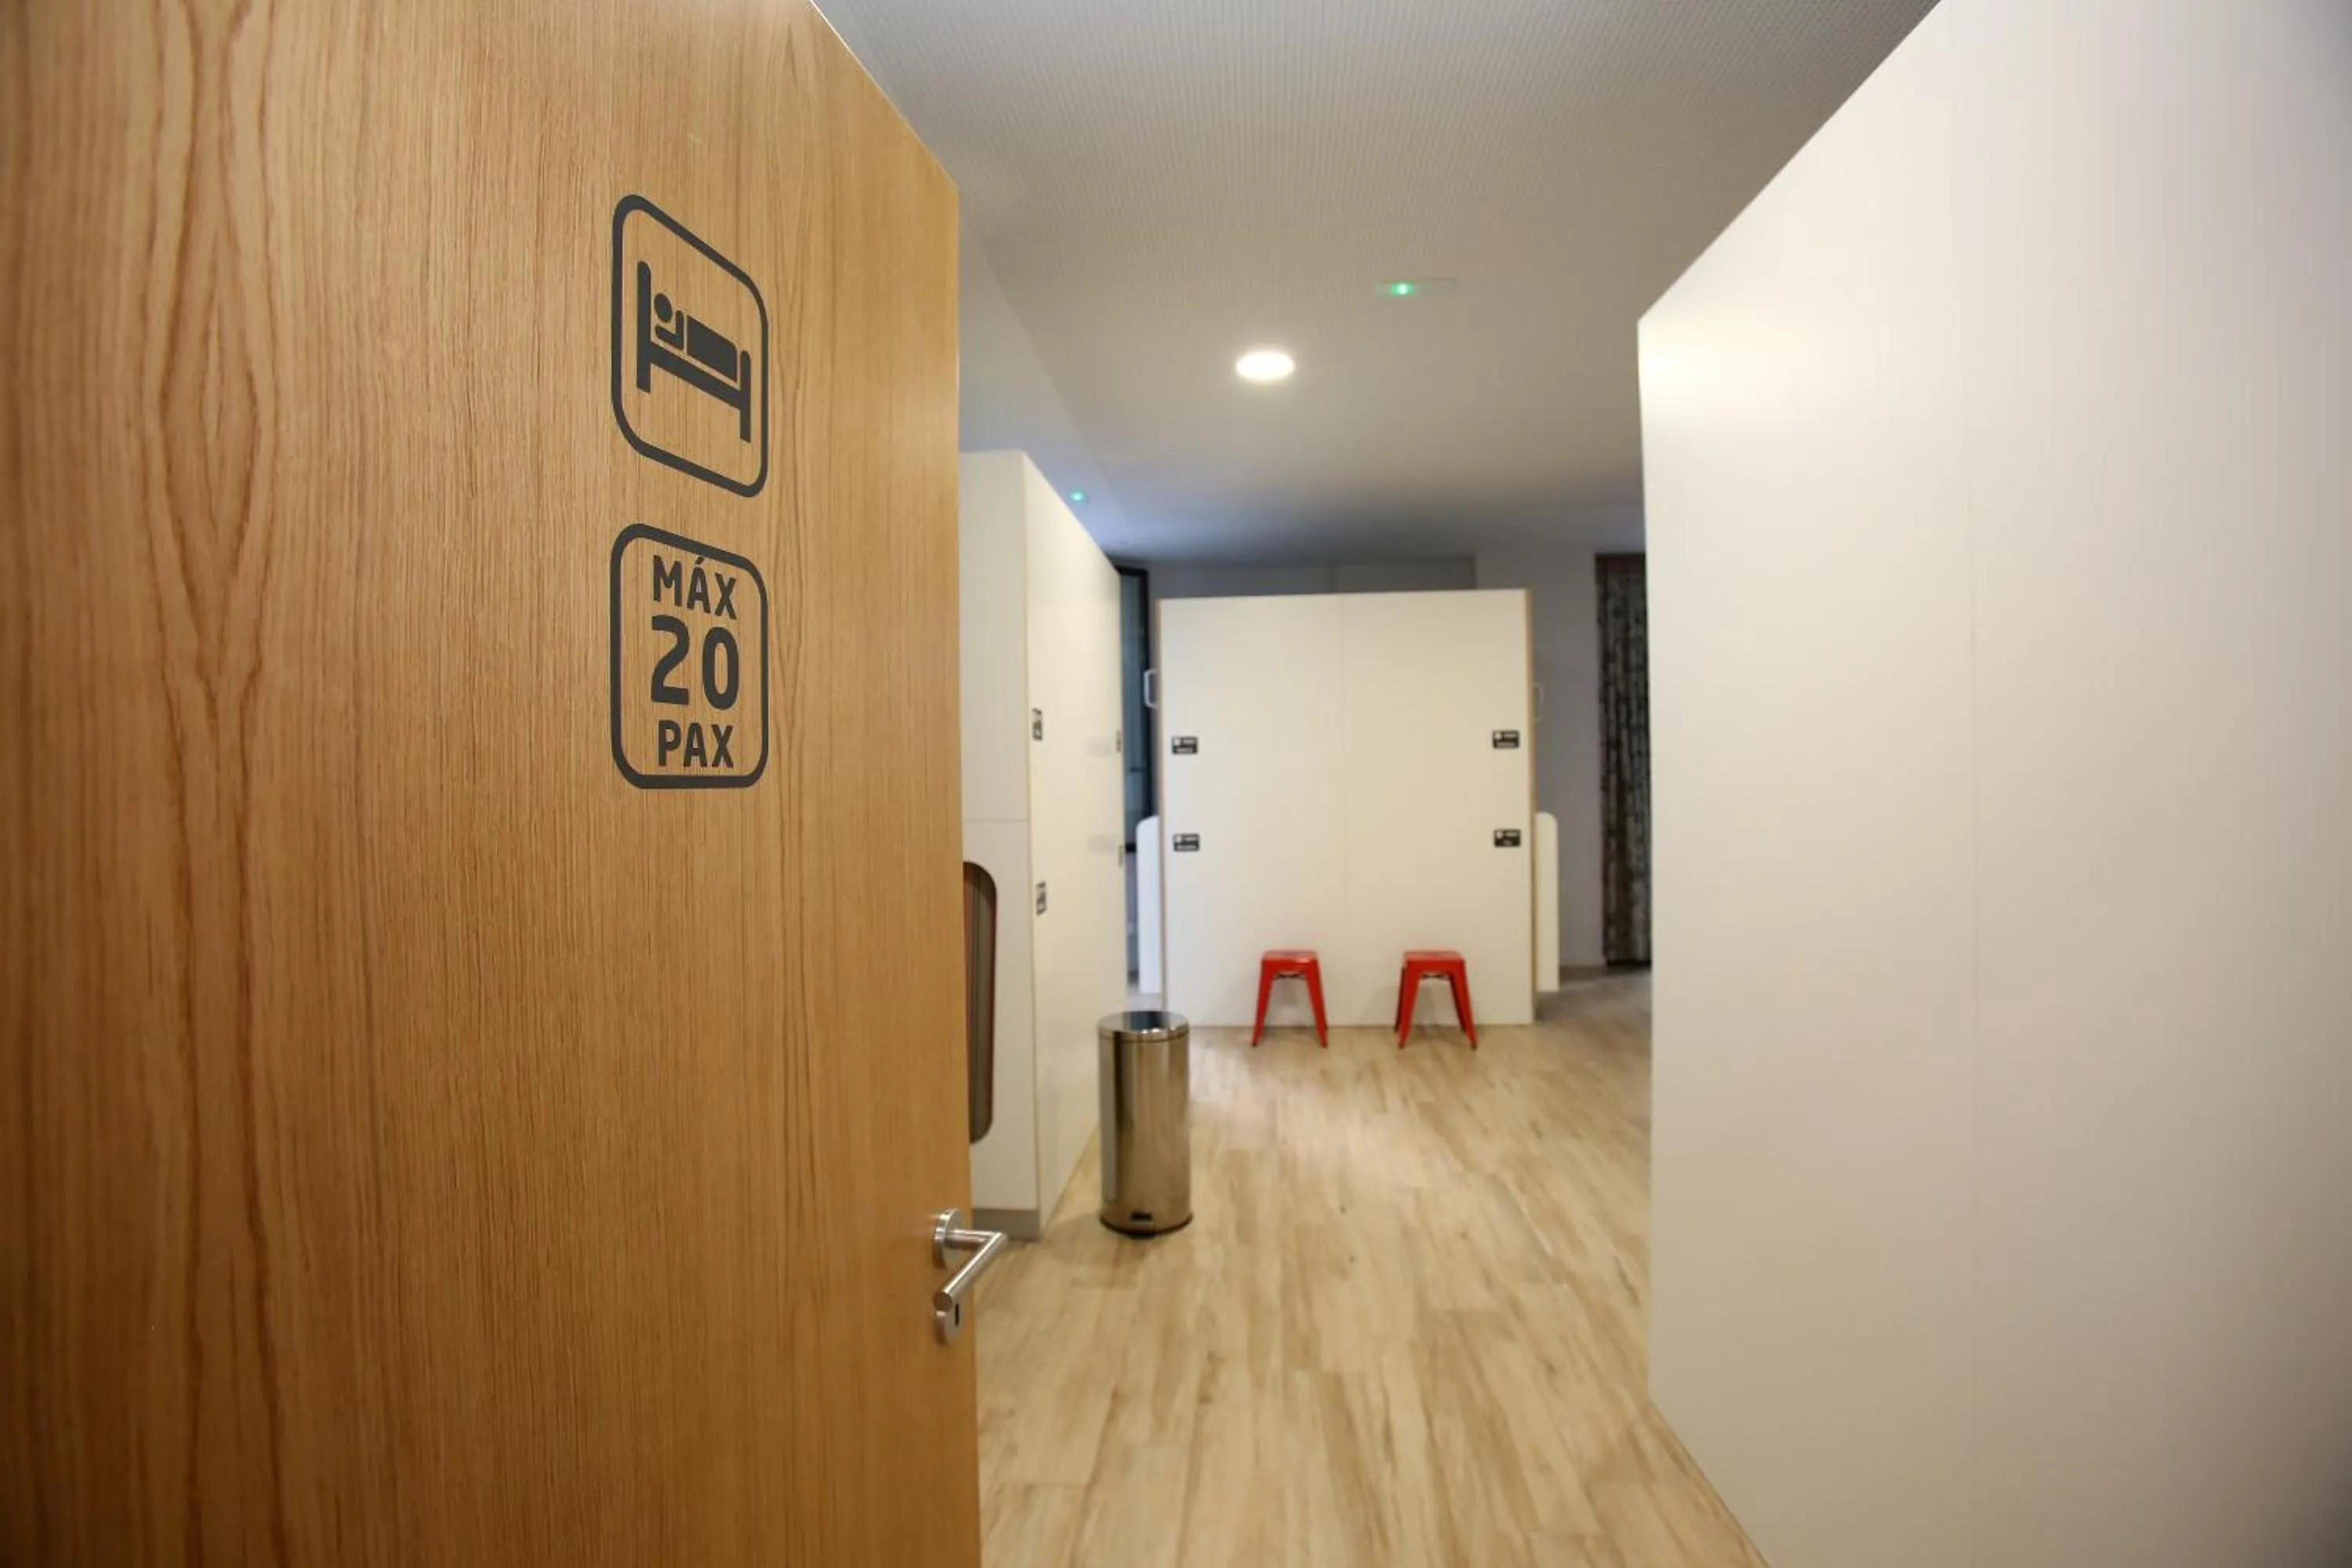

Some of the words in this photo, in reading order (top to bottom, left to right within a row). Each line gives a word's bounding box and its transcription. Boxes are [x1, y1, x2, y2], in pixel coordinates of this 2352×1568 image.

[652, 554, 737, 620] MÁX
[651, 614, 739, 711] 20
[658, 719, 735, 769] PAX
